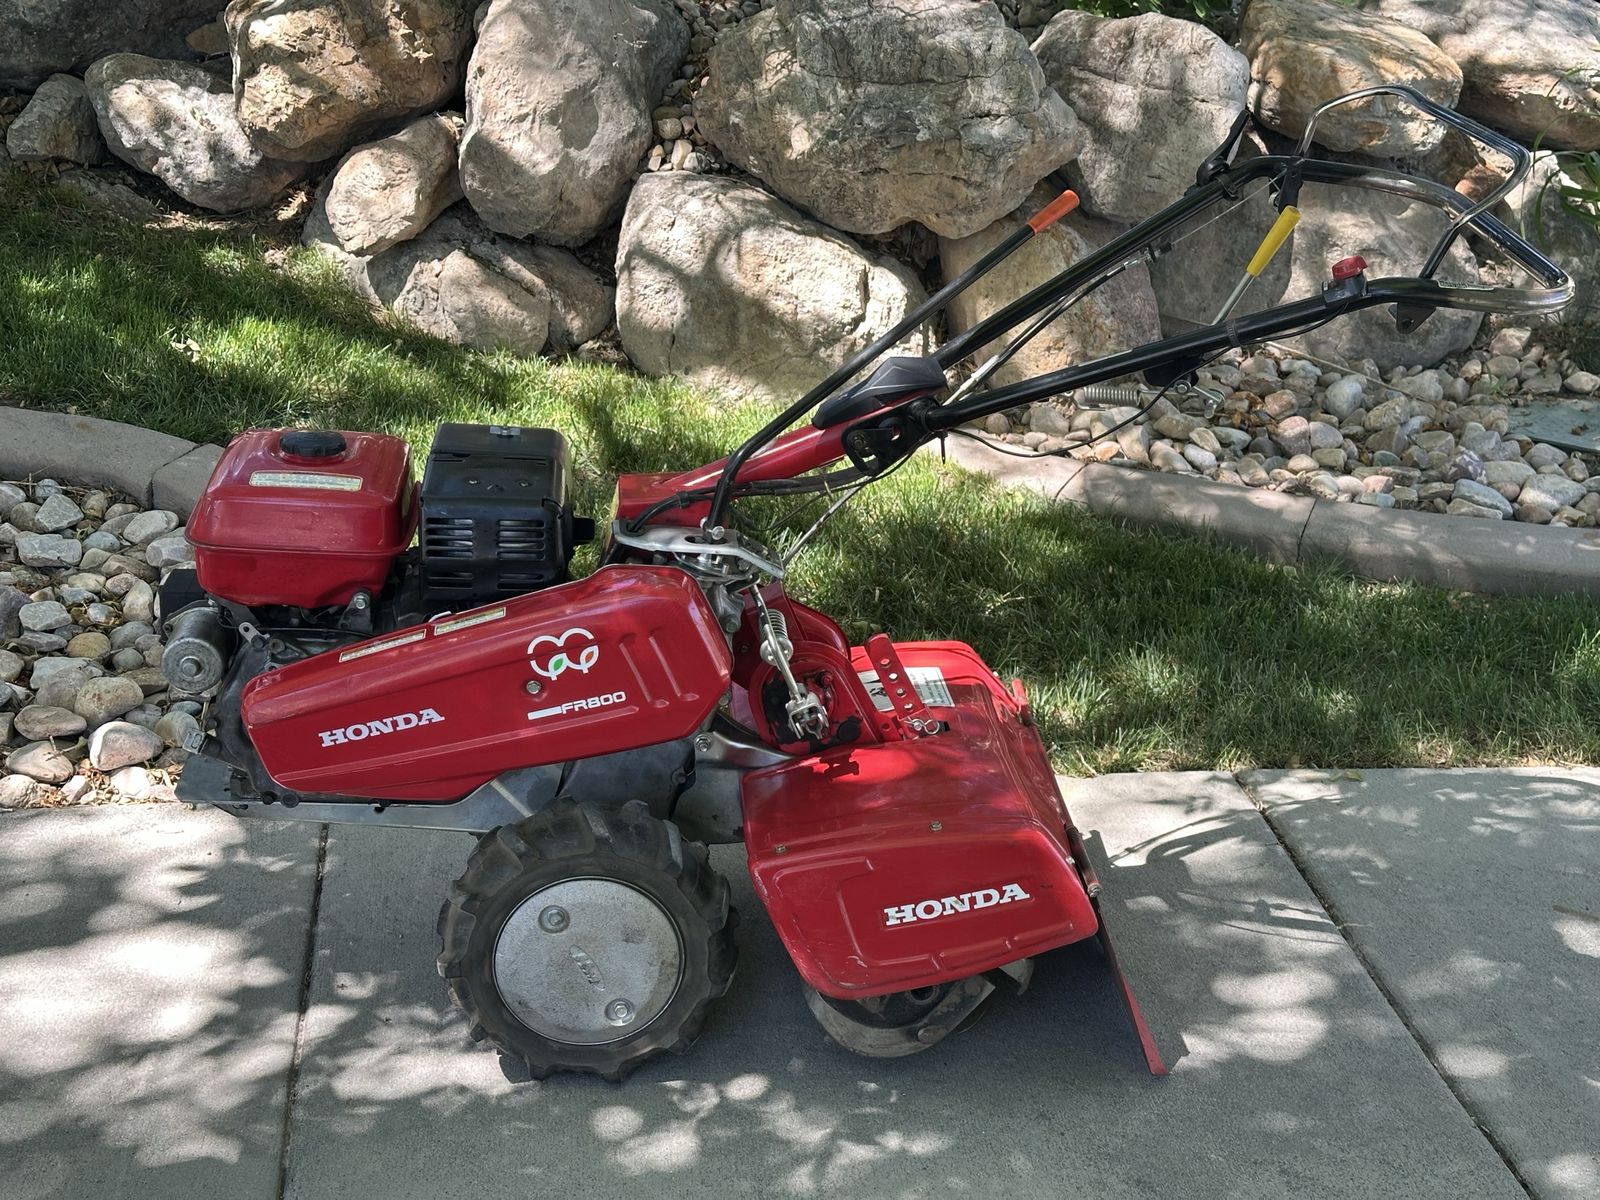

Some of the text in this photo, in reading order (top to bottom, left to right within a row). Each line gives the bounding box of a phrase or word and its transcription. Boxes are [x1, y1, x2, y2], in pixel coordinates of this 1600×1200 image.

[561, 691, 627, 714] FR800
[319, 709, 445, 747] HONDA
[884, 884, 1030, 925] HONDA
